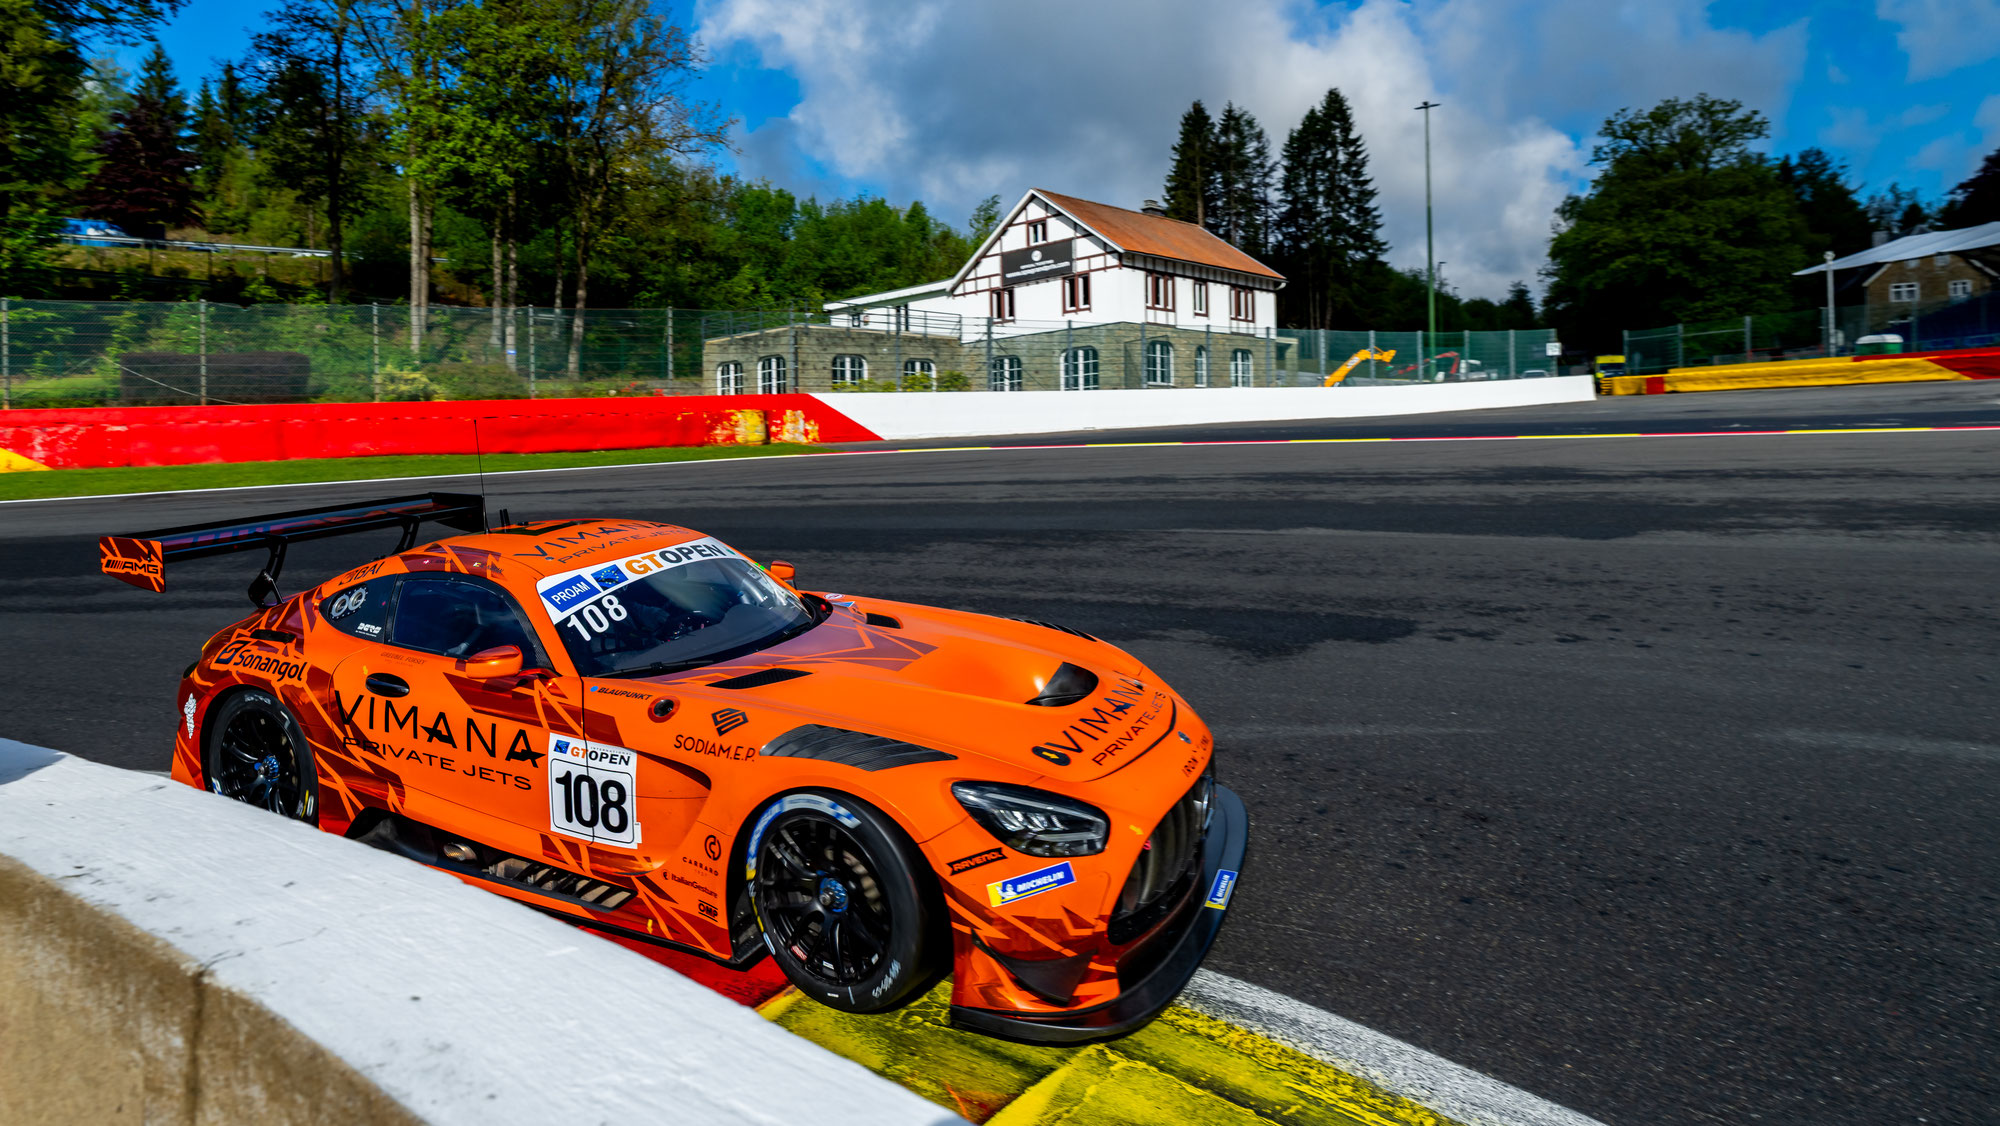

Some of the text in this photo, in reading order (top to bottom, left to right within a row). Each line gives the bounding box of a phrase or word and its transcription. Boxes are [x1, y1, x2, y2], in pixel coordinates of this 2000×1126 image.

[558, 534, 646, 564] PRIVATE
[121, 561, 159, 574] AMG
[551, 582, 591, 605] PROAM
[567, 594, 628, 642] 108
[233, 649, 307, 682] Sonangol
[597, 687, 653, 701] BLAUPUNKT
[335, 690, 546, 768] VIMANA
[1044, 678, 1146, 754] VIMANA
[1092, 711, 1155, 766] PRIVATE
[343, 737, 532, 790] PRIVATE JETS
[555, 770, 628, 834] 108
[682, 856, 719, 876] CARRARO
[1016, 871, 1065, 893] MICHELIN
[698, 903, 718, 918] OMP
